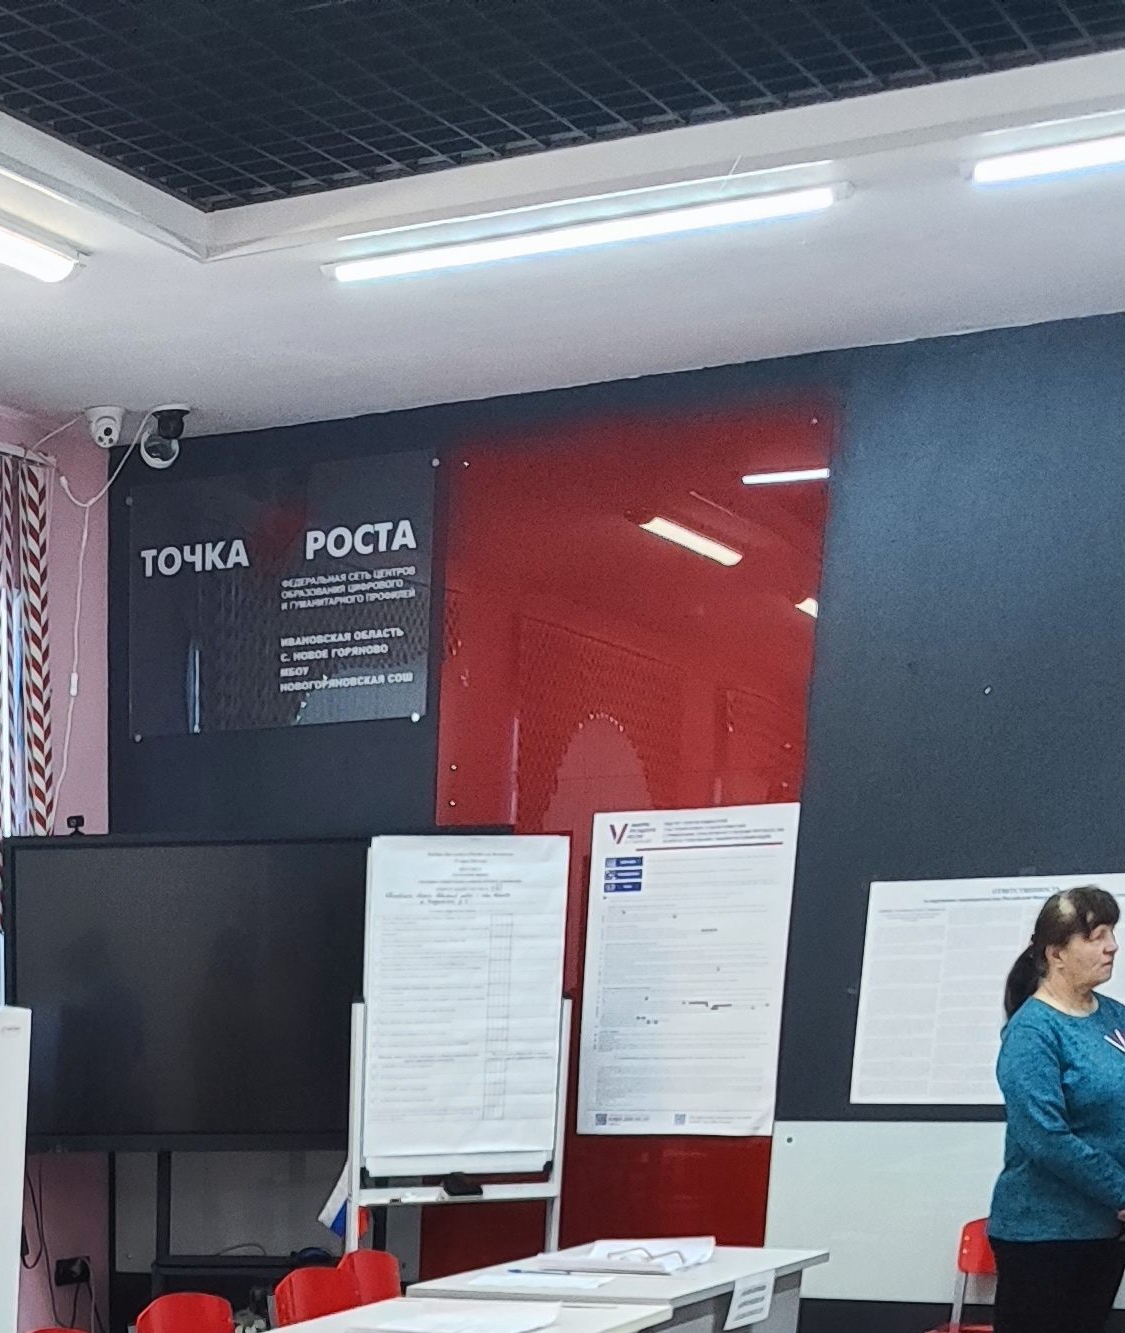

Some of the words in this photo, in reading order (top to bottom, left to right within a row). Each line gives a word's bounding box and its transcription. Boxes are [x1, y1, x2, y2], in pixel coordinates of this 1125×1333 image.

[139, 540, 250, 577] ТОЧКА
[306, 520, 416, 560] РОСТА
[280, 632, 351, 647] ИВАНОВСКАЯ
[354, 628, 404, 640] ОБЛАСТЬ
[293, 649, 328, 661] НОВОЕ
[332, 644, 389, 658] ГОРЯНОВО
[280, 667, 309, 677] МБОУ
[280, 675, 385, 692] НОВОГОРЯНОВСКАЯ
[387, 672, 414, 684] СОШ
